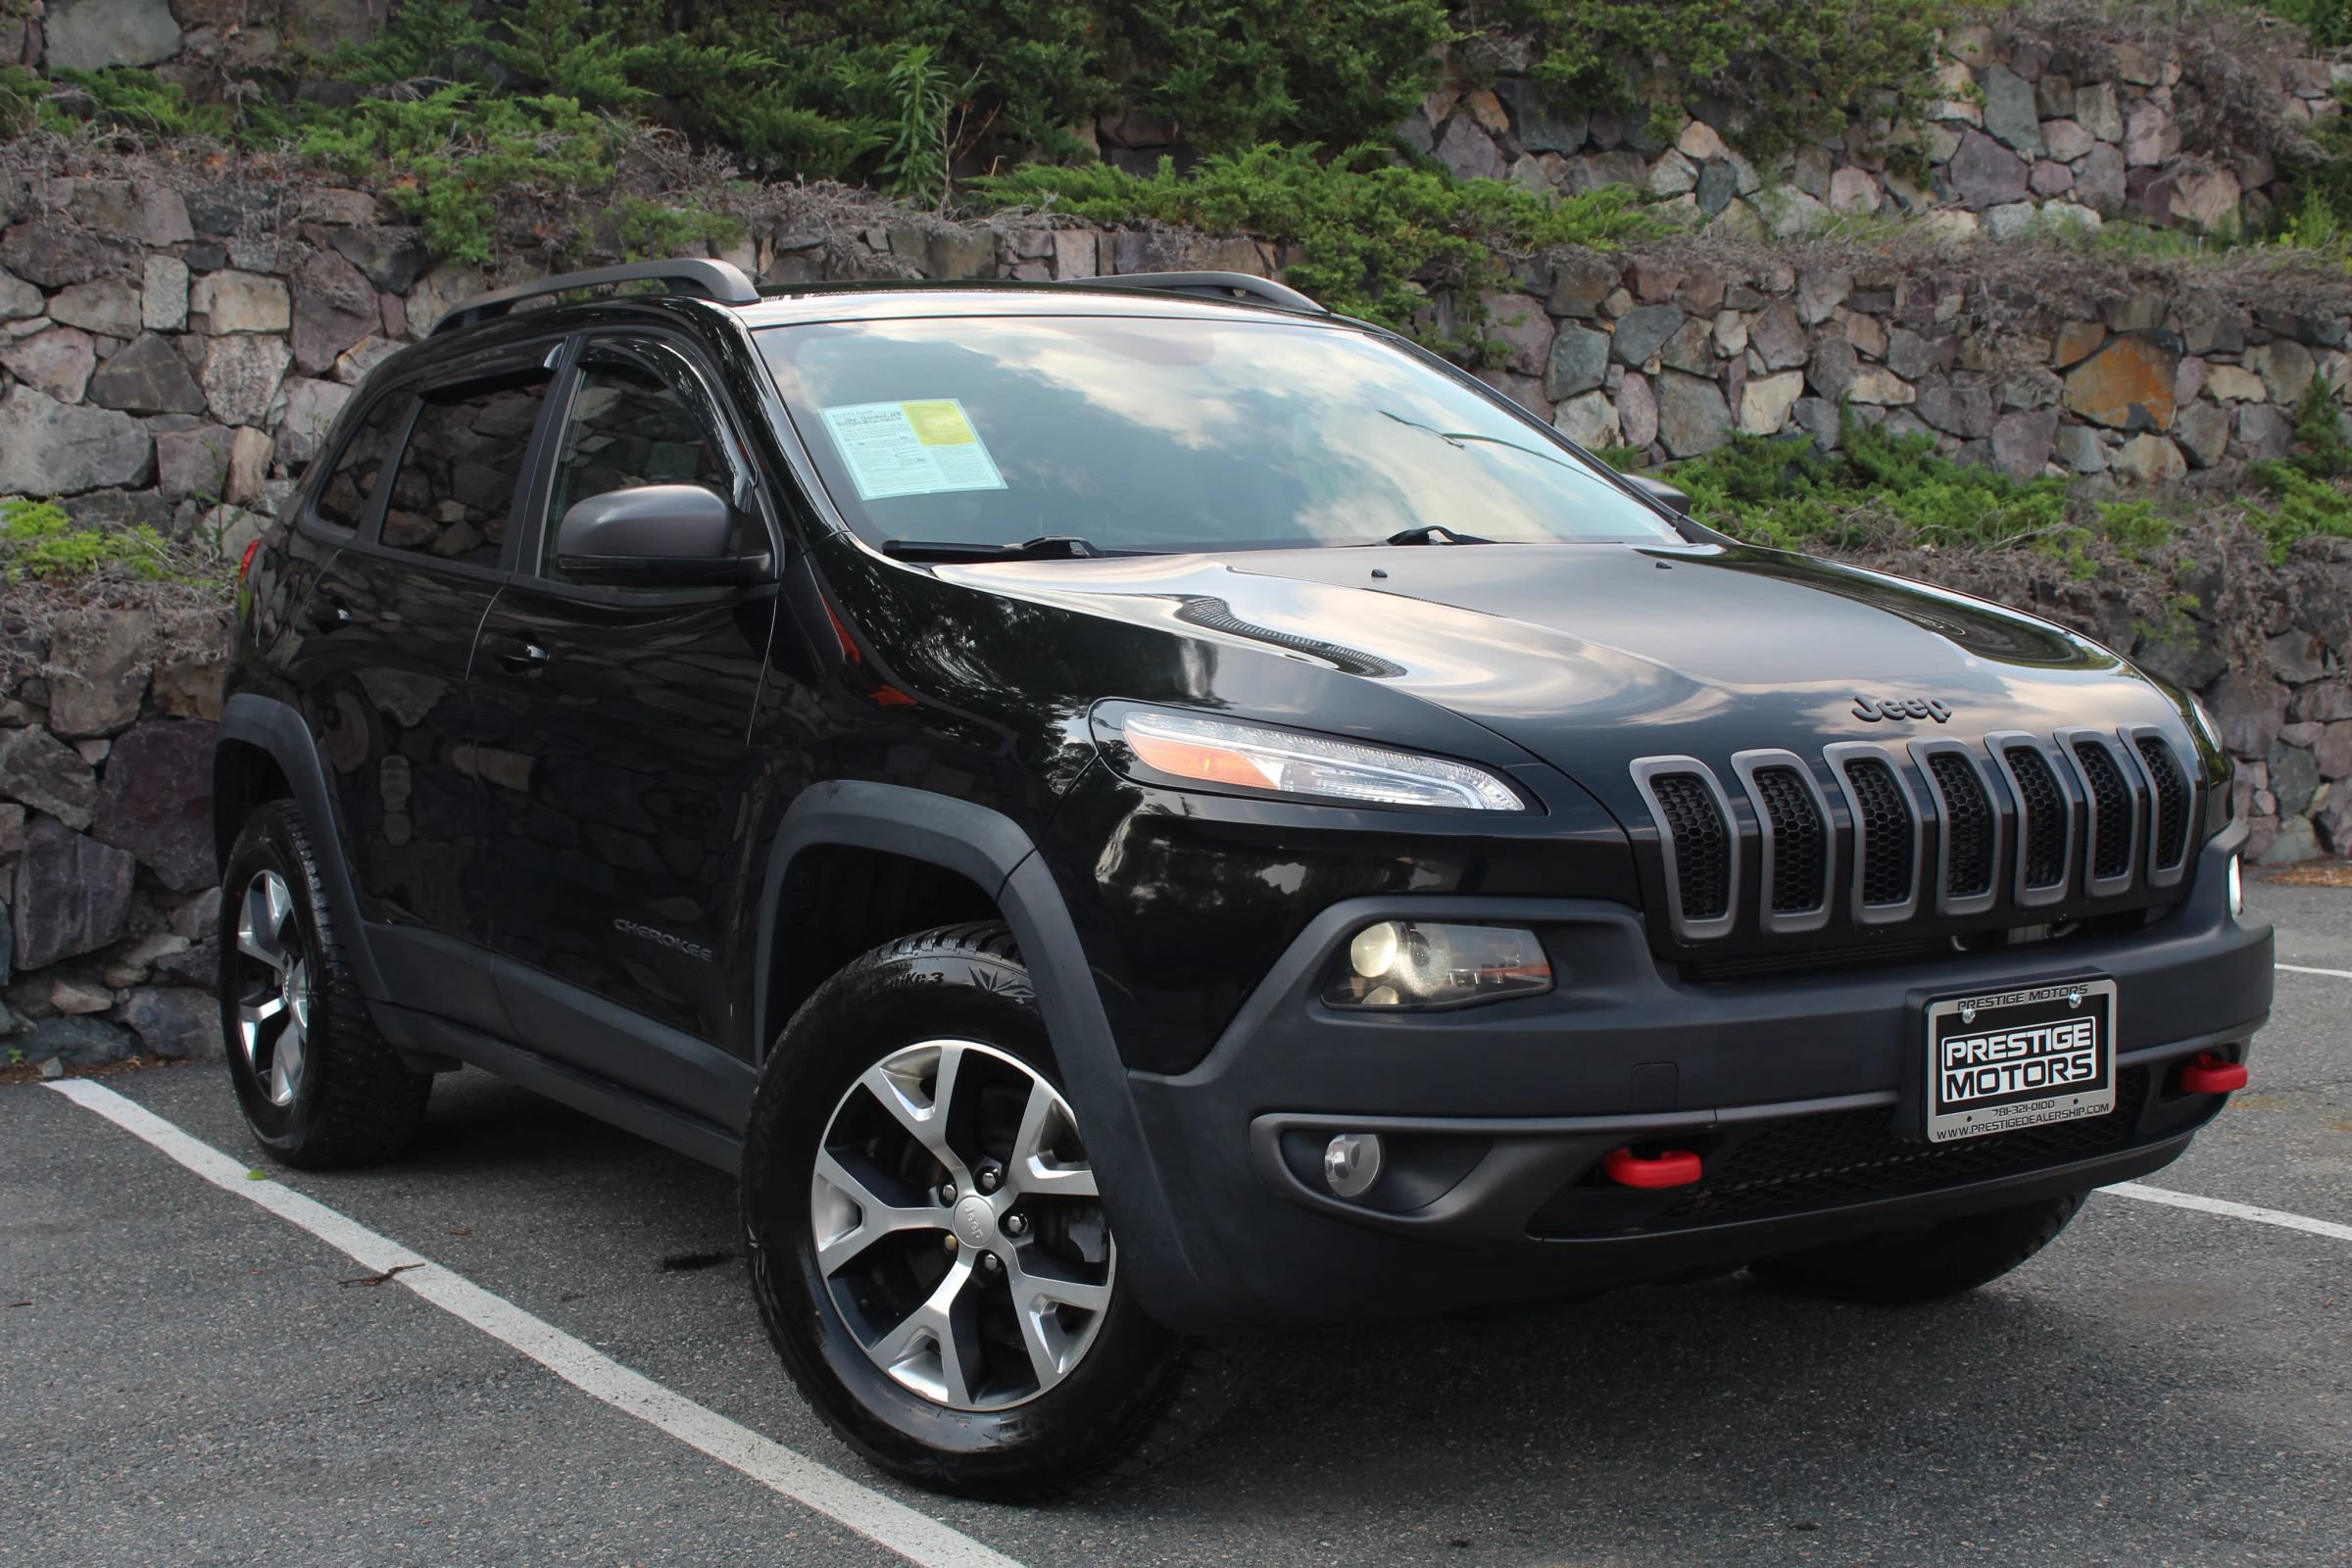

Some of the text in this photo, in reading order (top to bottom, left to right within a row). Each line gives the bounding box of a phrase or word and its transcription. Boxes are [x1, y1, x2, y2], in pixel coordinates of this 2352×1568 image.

[1851, 694, 1952, 723] Jeep
[613, 918, 713, 962] CHEROKEE
[1957, 984, 2088, 1011] PRESTIGE MOTORS
[1946, 1022, 2091, 1067] PRESTIGE
[1946, 1054, 2092, 1101] MOTORS
[1936, 1103, 2109, 1140] WWW.PRESTIGEDEALERSHIP.COM
[1991, 1100, 2055, 1117] 781-321-0100
[963, 1202, 984, 1239] Jeep
